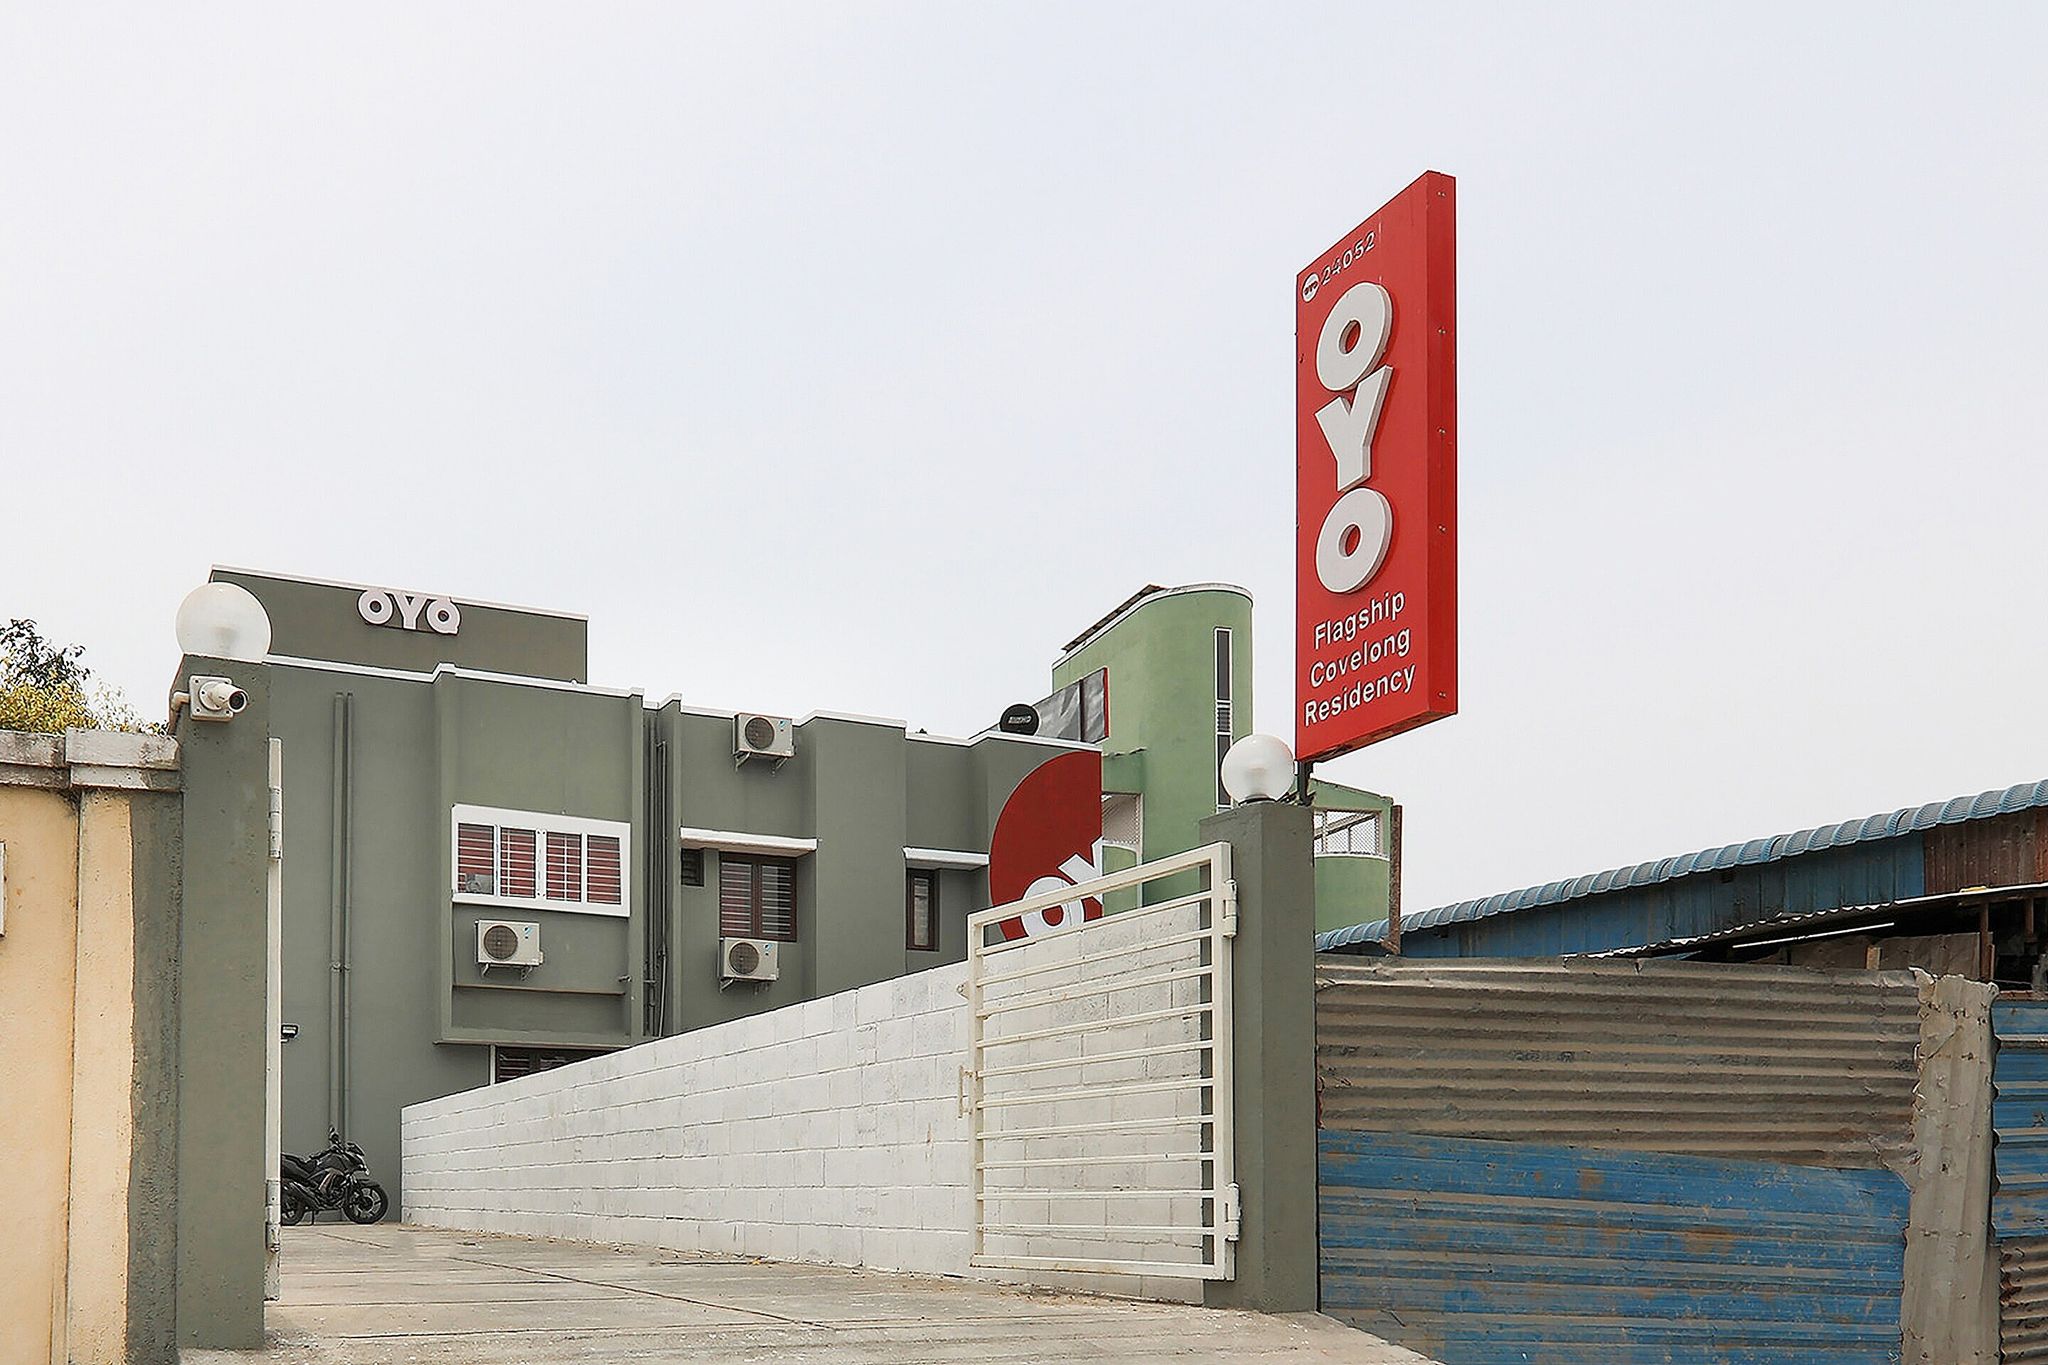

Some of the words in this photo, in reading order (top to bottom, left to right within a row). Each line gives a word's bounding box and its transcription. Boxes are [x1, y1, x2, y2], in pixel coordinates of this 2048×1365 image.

[1323, 232, 1375, 285] 24052
[1315, 282, 1394, 593] OYO
[358, 589, 461, 634] OYO
[1315, 592, 1405, 650] Flagship
[1311, 628, 1411, 688] Covelong
[1305, 664, 1416, 726] Residency
